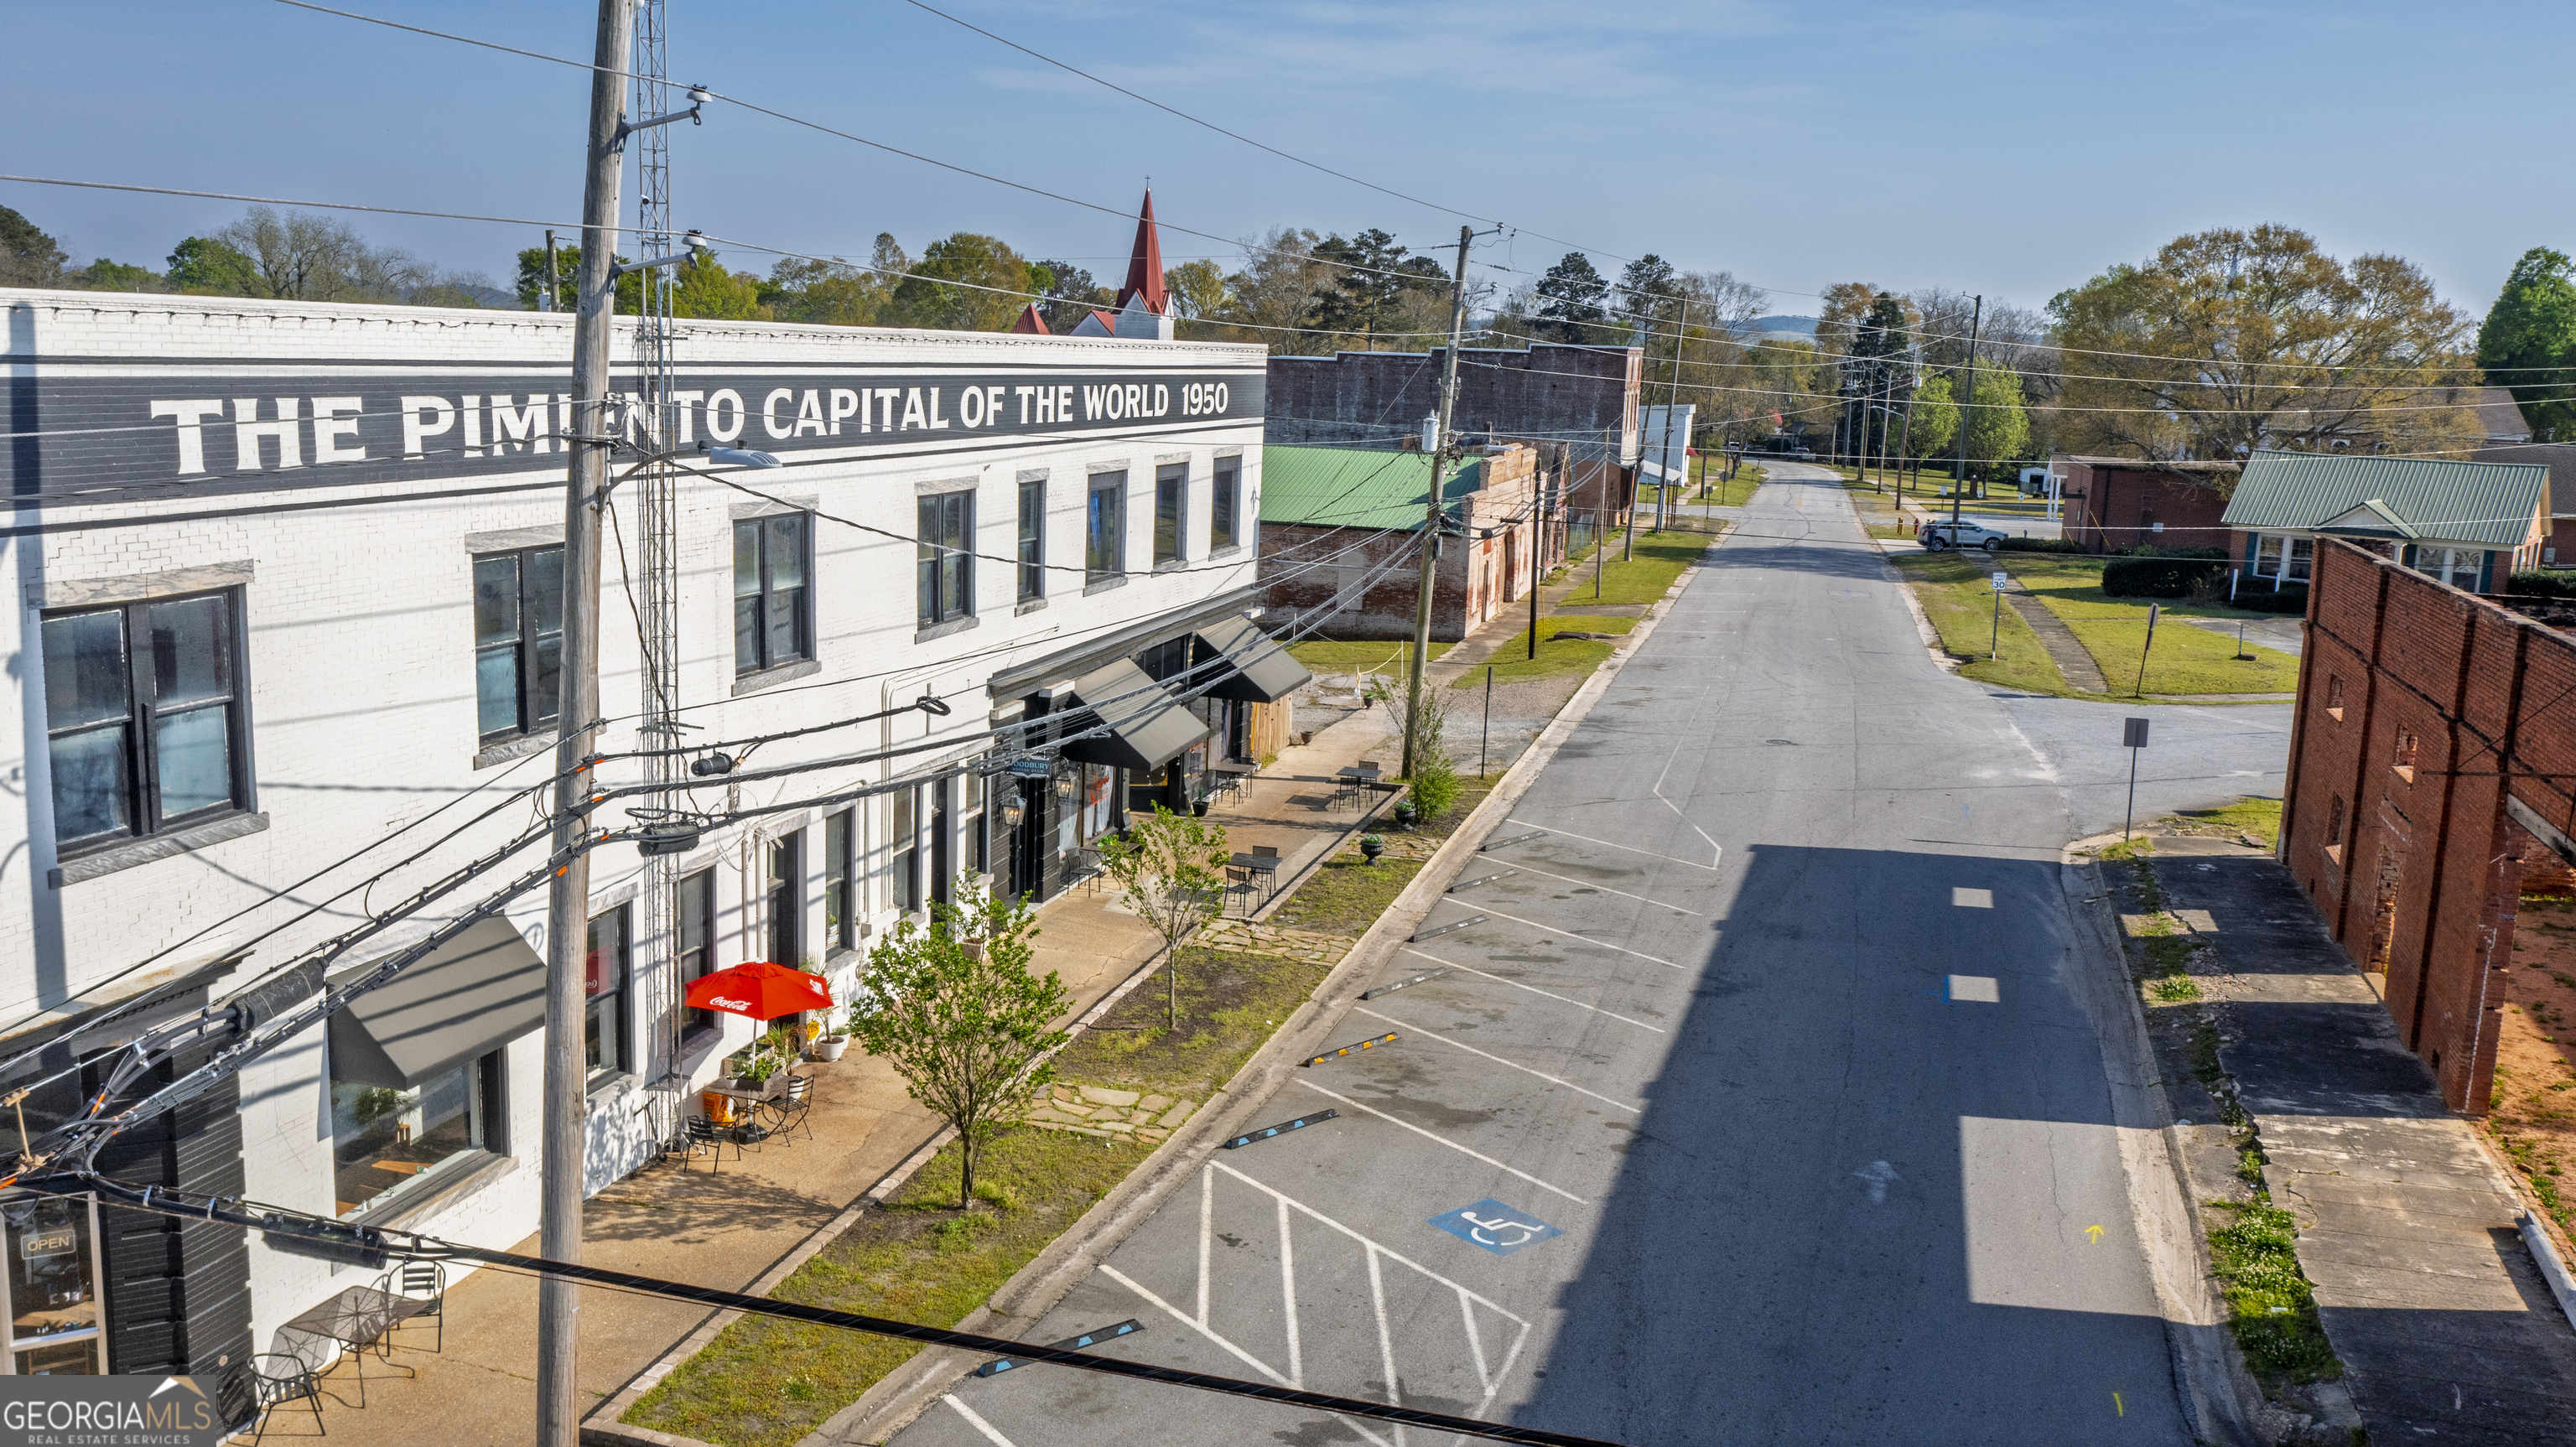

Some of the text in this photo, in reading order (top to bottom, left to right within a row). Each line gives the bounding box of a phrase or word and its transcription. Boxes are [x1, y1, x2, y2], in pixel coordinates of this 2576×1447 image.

[151, 397, 366, 475] THE
[763, 387, 949, 440] CAPITAL
[960, 386, 1005, 428] OF
[1015, 386, 1073, 424] THE
[1083, 383, 1169, 420] WORLD
[1182, 382, 1228, 415] 1950
[1013, 760, 1050, 770] OODBURY
[28, 1237, 70, 1253] OPEN
